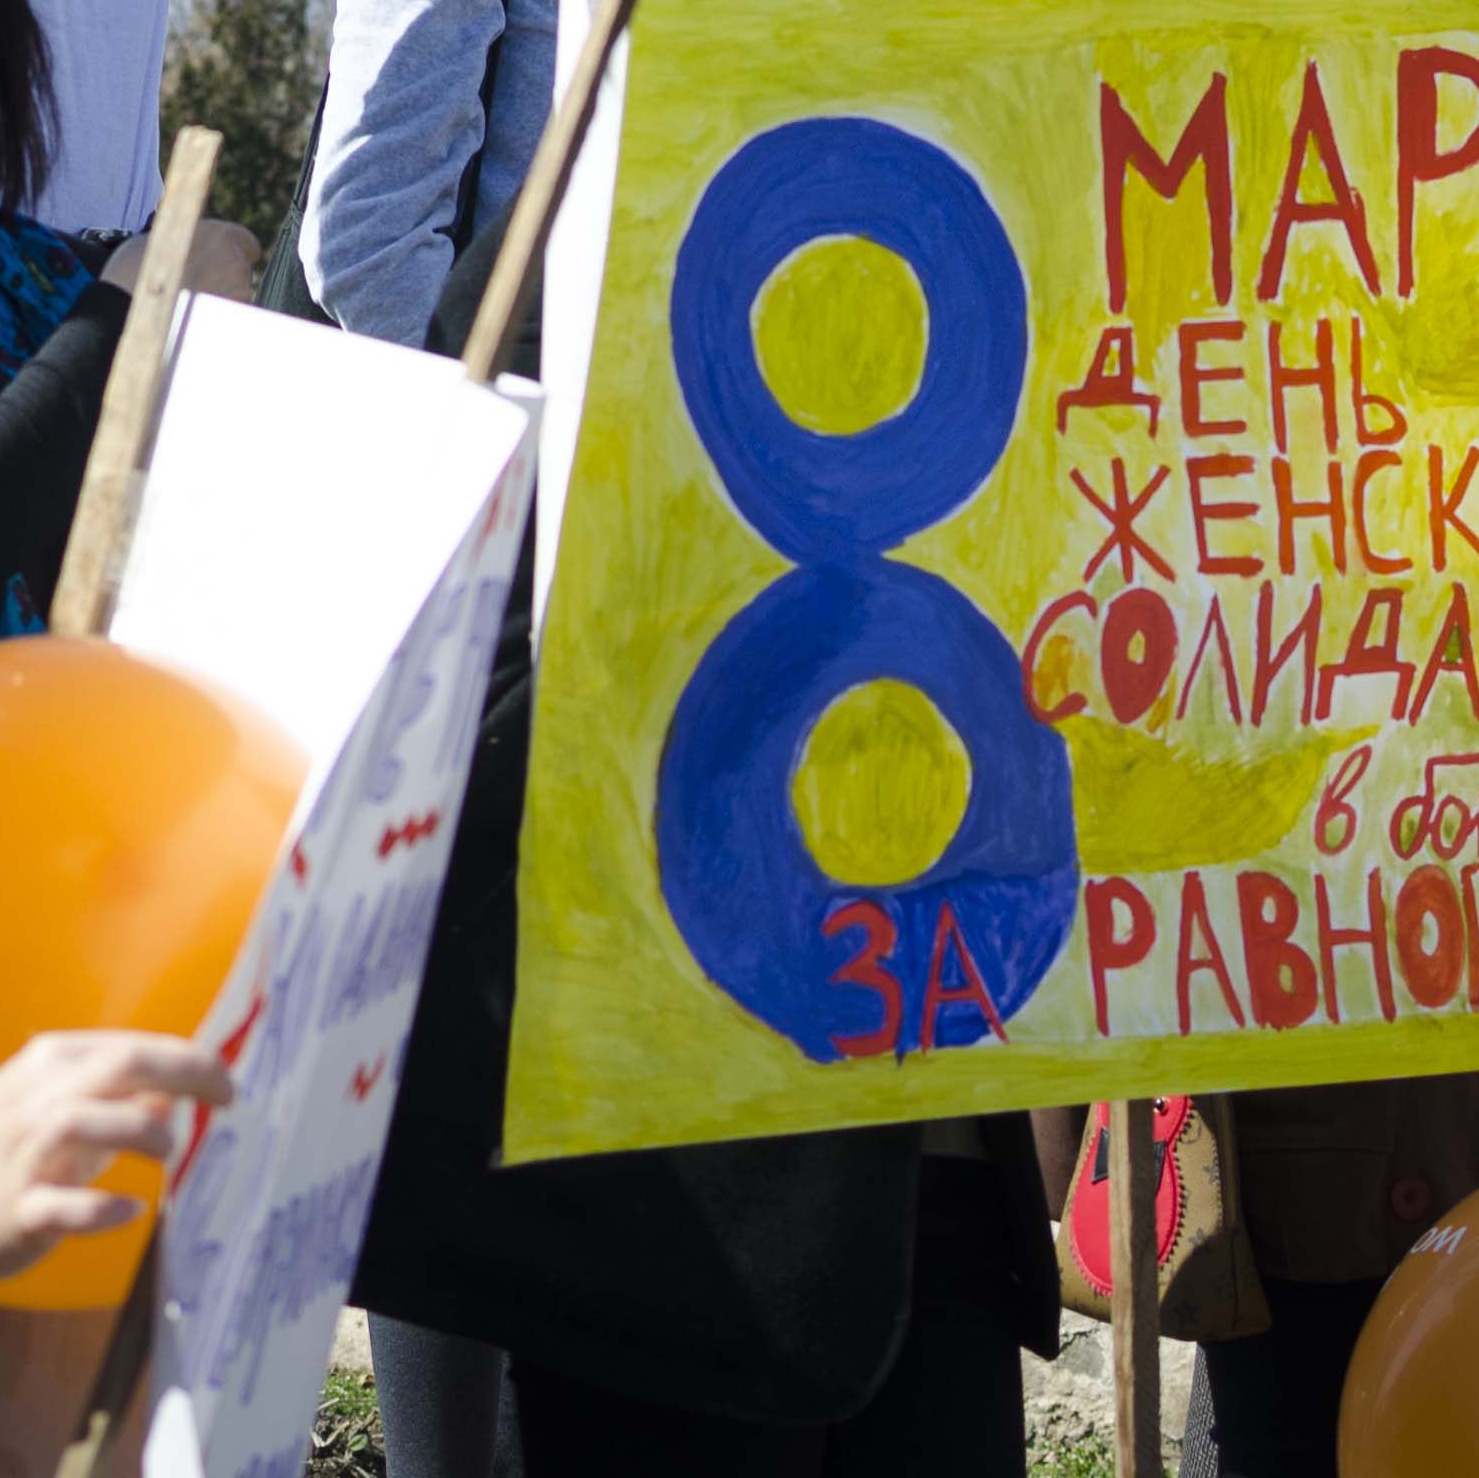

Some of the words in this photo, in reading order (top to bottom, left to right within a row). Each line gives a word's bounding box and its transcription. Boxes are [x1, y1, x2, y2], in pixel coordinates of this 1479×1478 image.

[1057, 317, 1408, 451] ДЕНЬ
[655, 116, 1079, 1064] 8
[820, 898, 1011, 1059] ЗА
